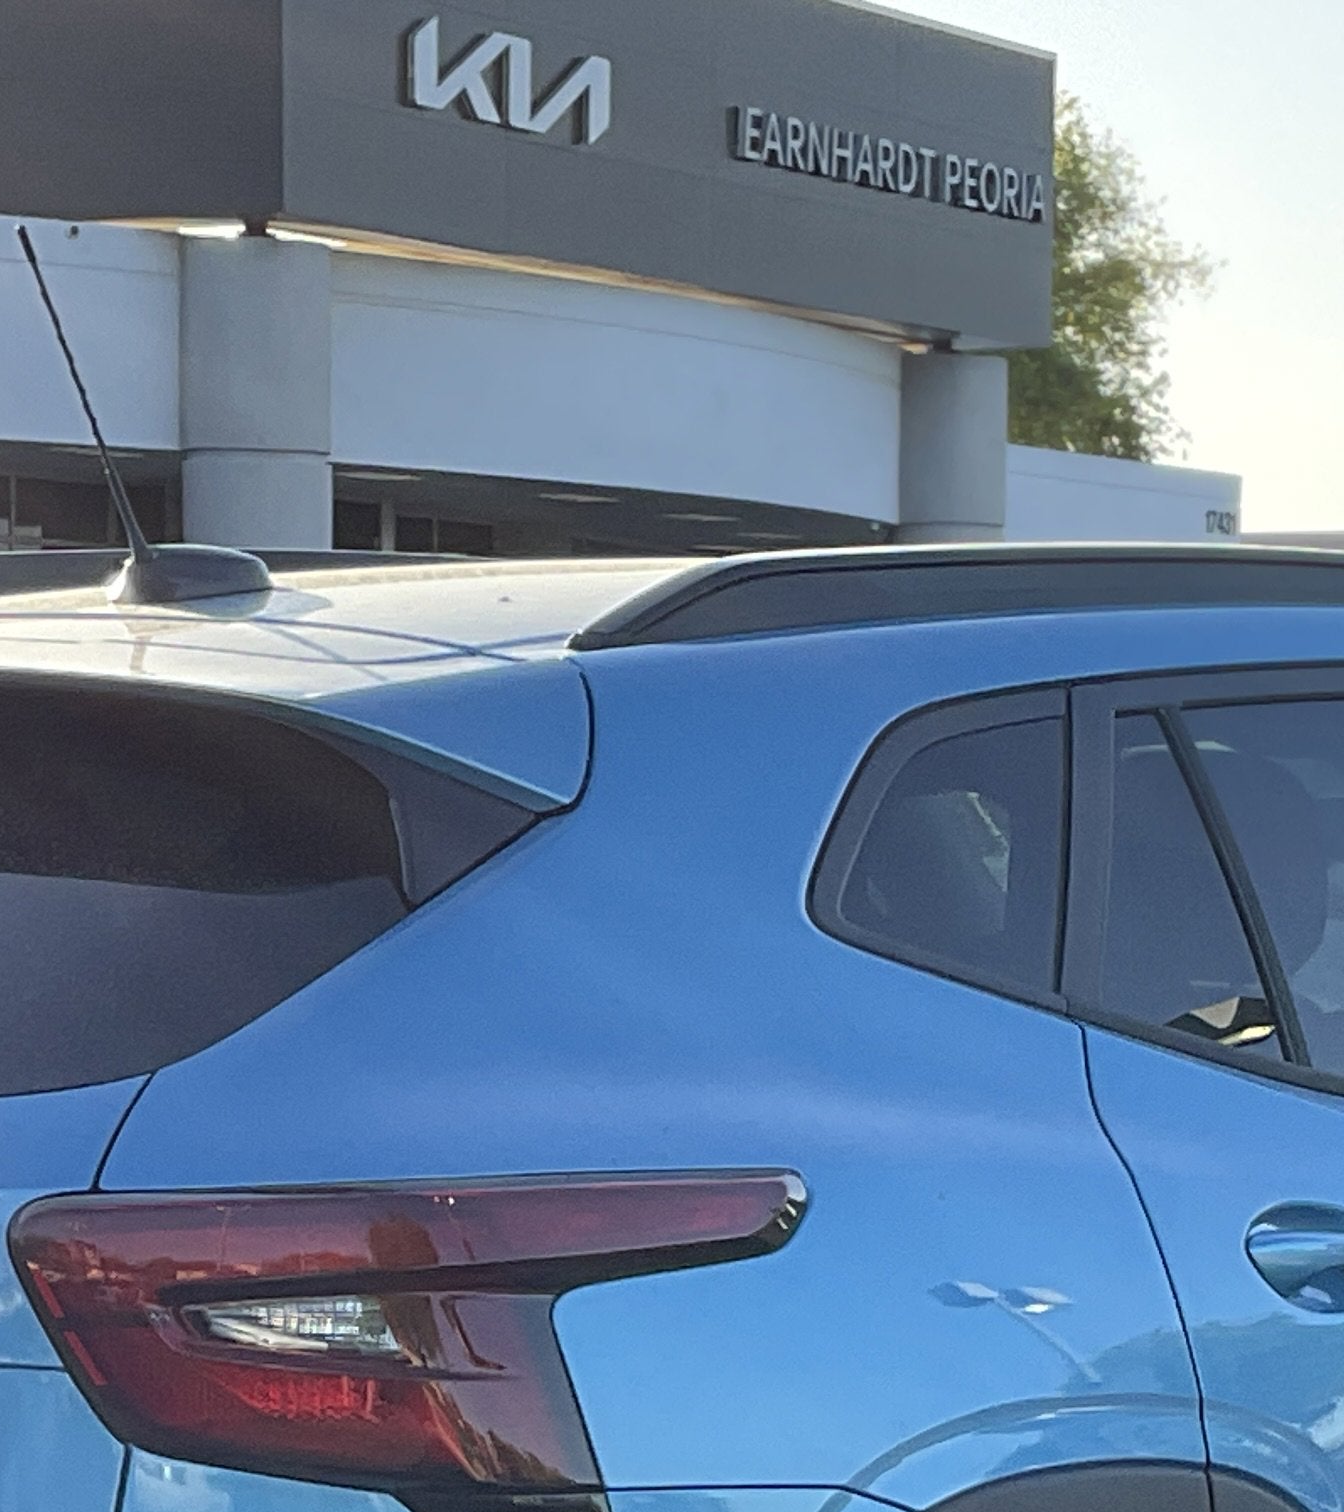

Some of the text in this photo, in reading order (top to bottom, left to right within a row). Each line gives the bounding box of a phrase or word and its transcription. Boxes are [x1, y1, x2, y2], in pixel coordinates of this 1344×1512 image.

[408, 16, 612, 146] KIA
[742, 107, 1047, 223] EARNHARDT PEORIA
